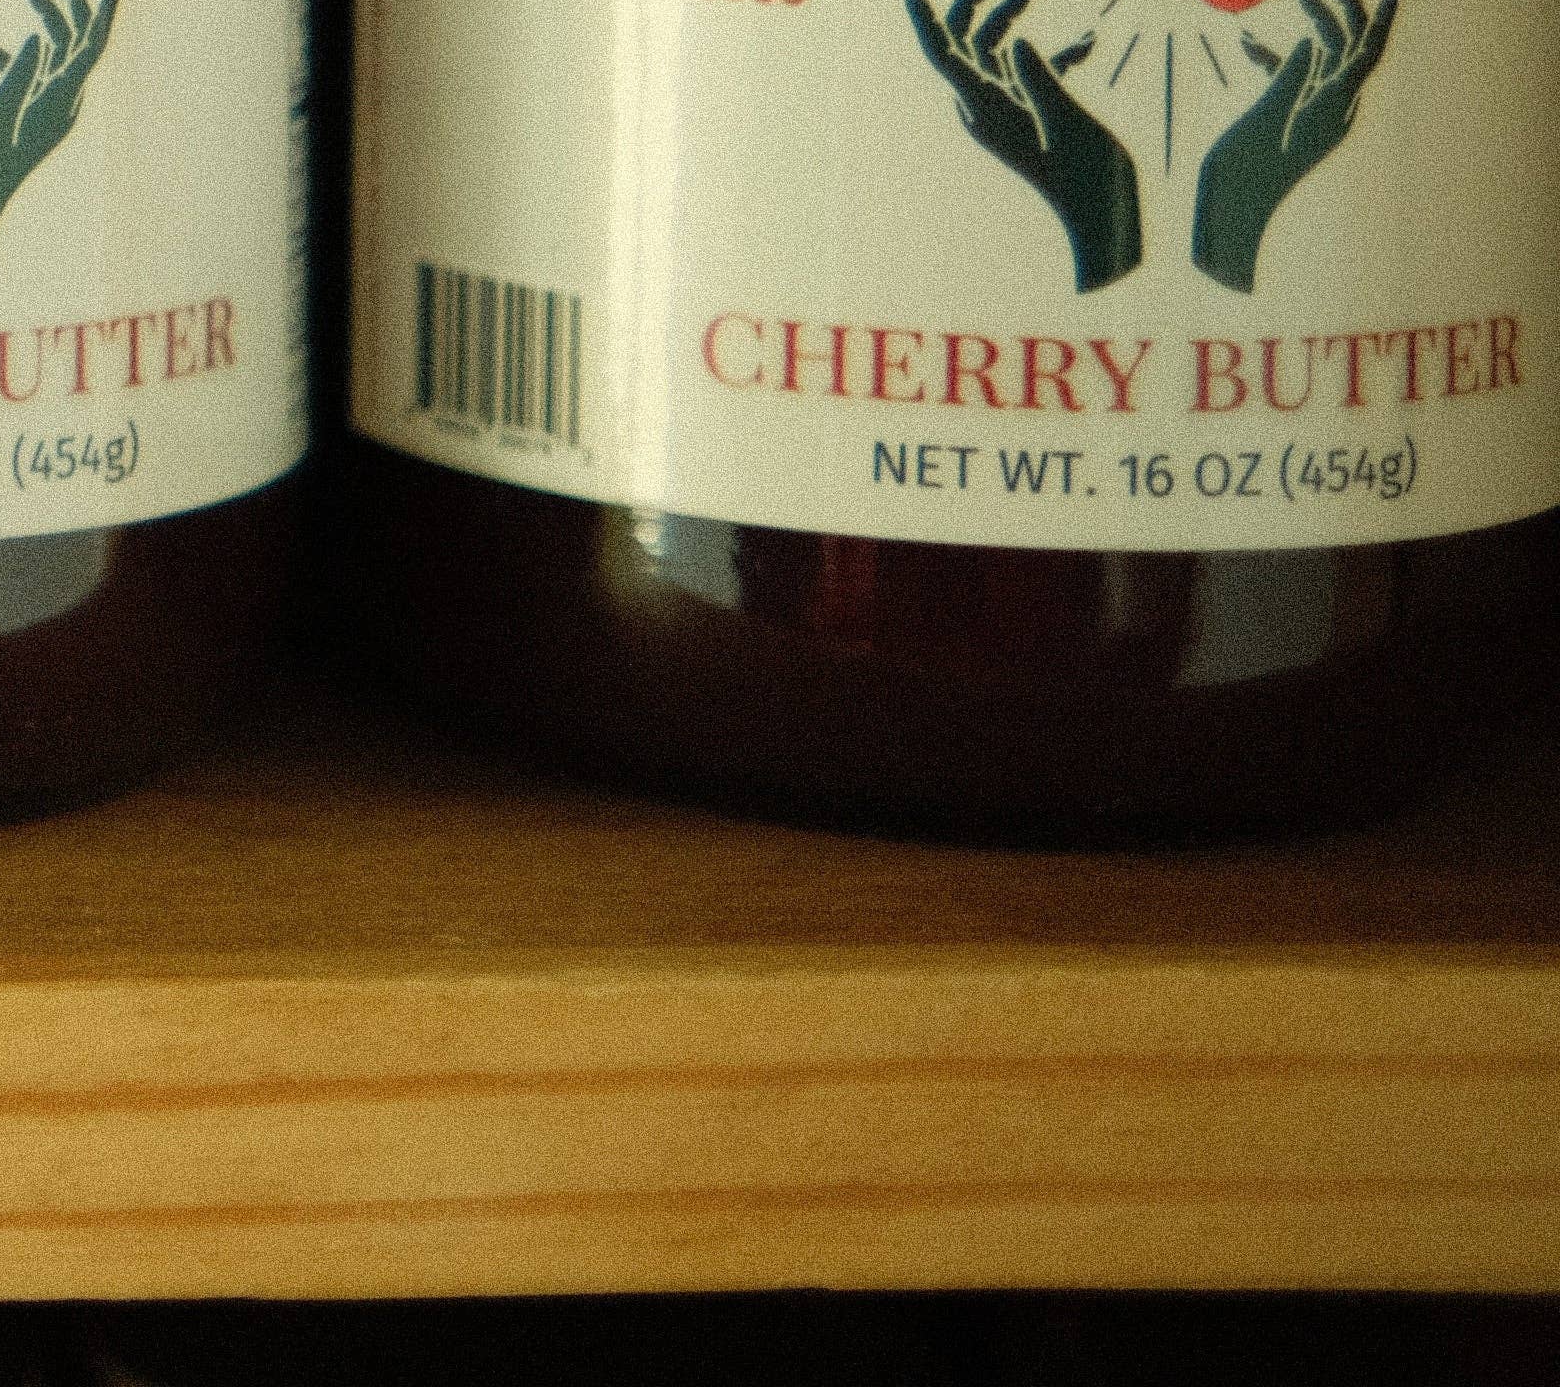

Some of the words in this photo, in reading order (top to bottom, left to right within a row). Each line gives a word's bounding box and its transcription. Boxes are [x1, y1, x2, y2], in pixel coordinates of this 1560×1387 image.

[701, 313, 1154, 413] CHERRY
[1188, 313, 1522, 416] BUTTER
[10, 423, 142, 488] (454g)
[871, 440, 978, 489] NET
[998, 450, 1097, 496] WT.
[1119, 454, 1175, 498] 16
[1193, 452, 1263, 498] OZ
[1279, 436, 1418, 502] (454g)
